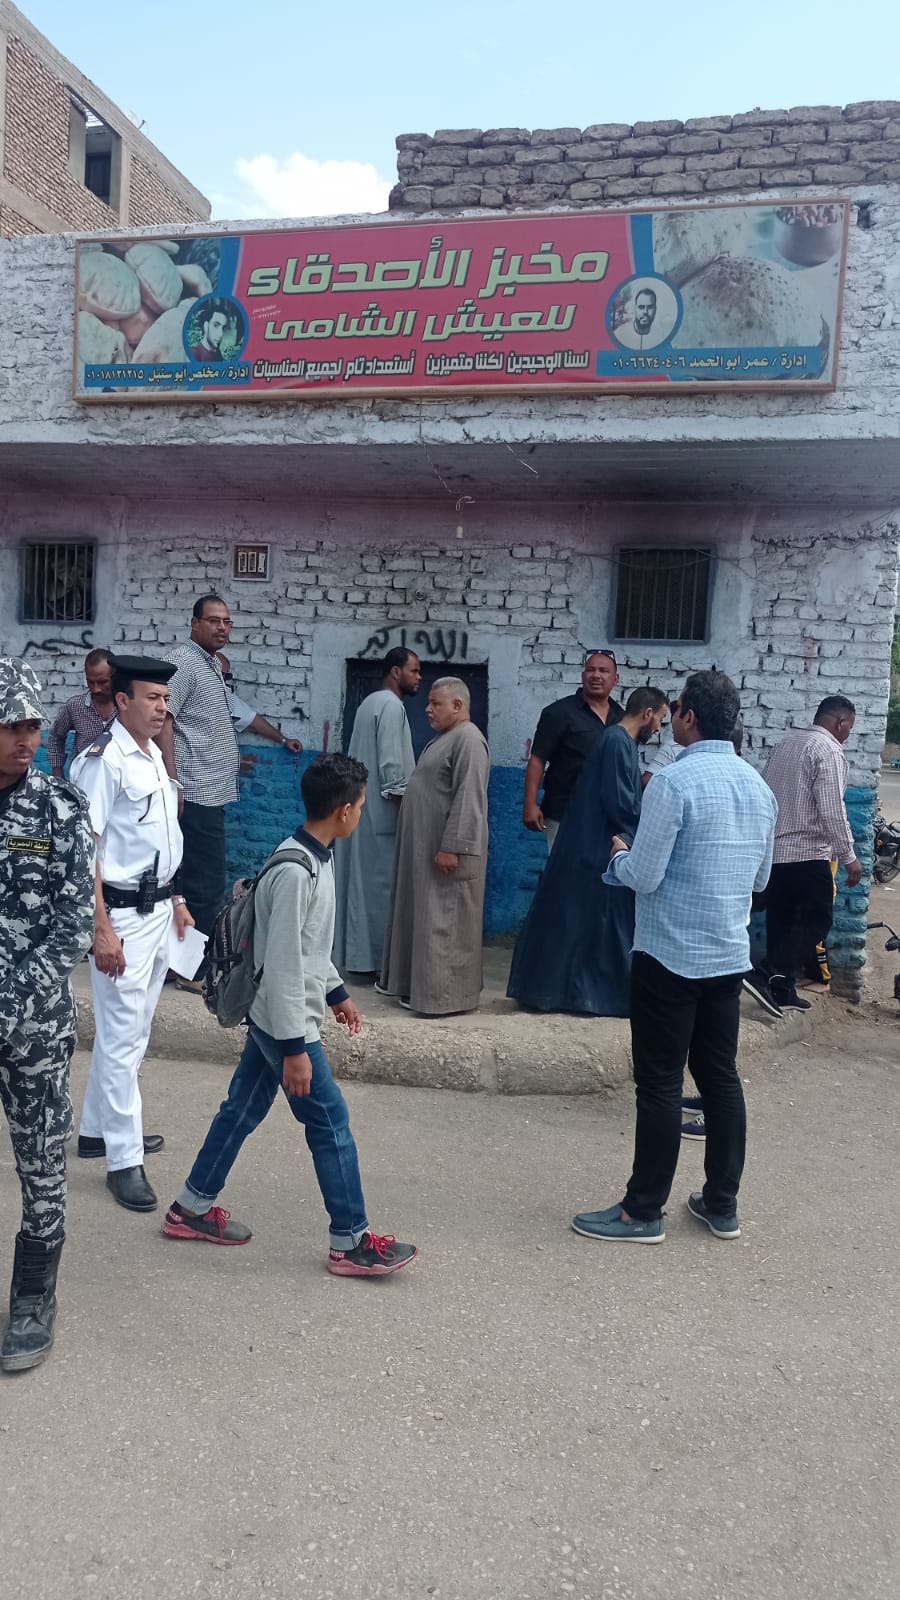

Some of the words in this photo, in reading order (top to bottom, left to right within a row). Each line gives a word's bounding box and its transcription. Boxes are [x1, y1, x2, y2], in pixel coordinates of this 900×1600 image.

[247, 236, 472, 297] الأصدقاء
[478, 242, 610, 298] مخبز
[422, 299, 577, 342] للعيش
[252, 358, 305, 382] المناسبات
[305, 357, 343, 381] لجميع
[343, 356, 367, 381] تام
[425, 352, 474, 376] متميزين
[474, 351, 504, 371] لكننا
[506, 350, 563, 375] الوحيدين
[563, 350, 590, 369] لسنا
[689, 354, 724, 368] الحمد
[743, 354, 769, 370] عمر
[188, 367, 220, 382] مخلص
[415, 628, 468, 660] الله
